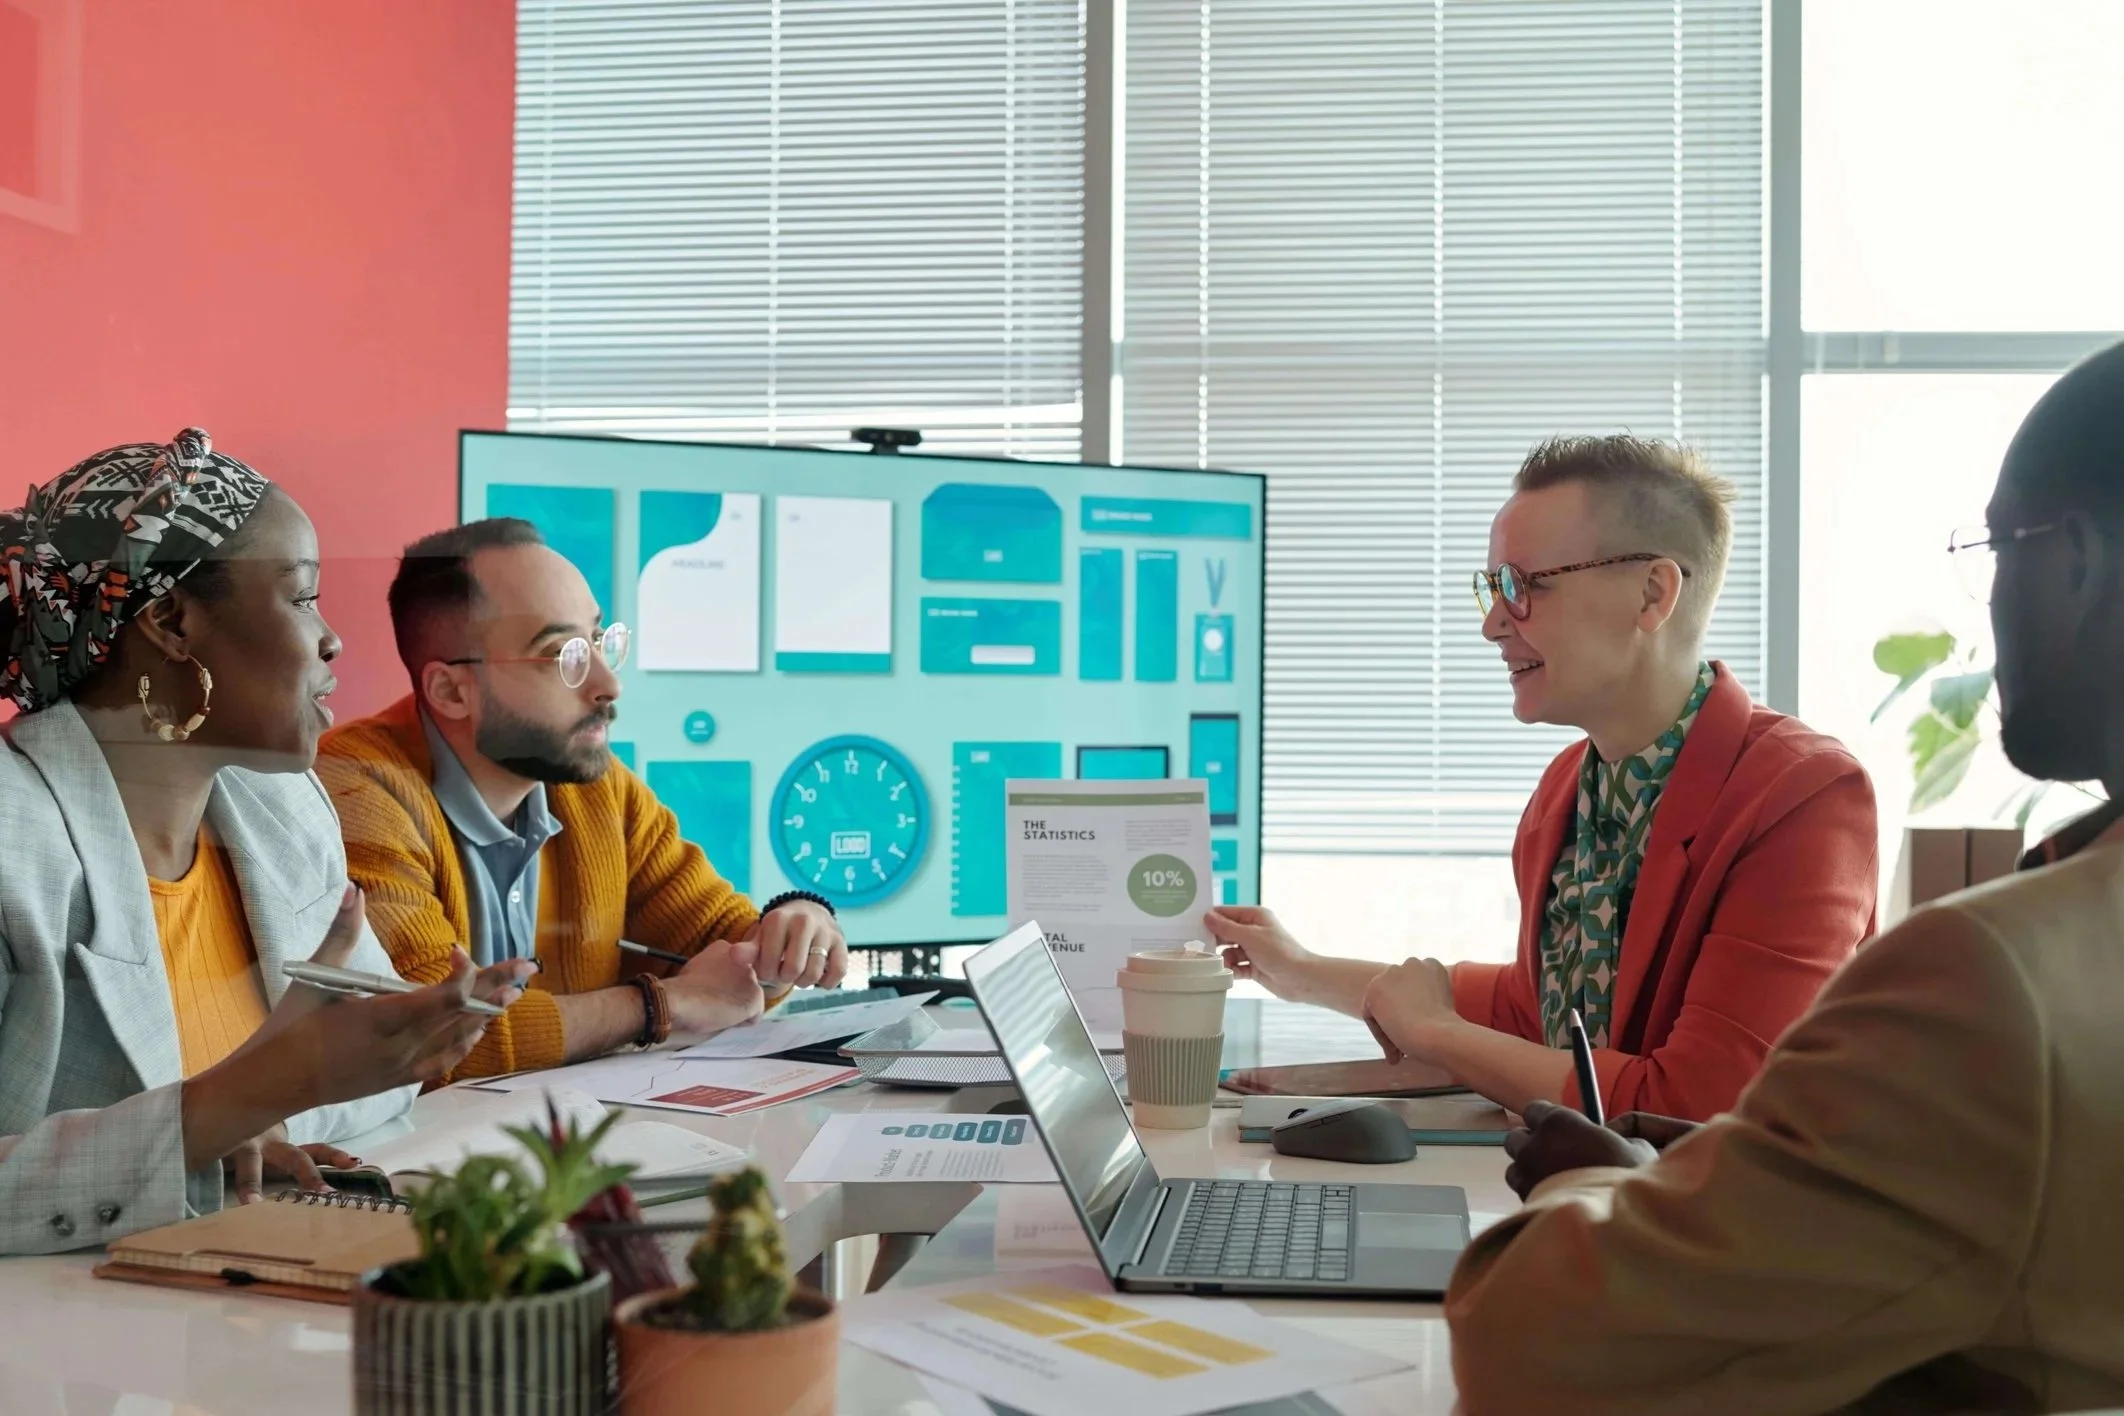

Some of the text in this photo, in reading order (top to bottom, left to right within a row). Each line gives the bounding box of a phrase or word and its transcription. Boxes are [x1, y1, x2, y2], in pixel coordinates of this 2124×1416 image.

[1023, 820, 1047, 830] THE
[1024, 830, 1096, 840] STATISTICS
[844, 866, 855, 881] 6
[1142, 870, 1185, 888] 10%
[1043, 932, 1068, 943] TAL
[1048, 943, 1086, 953] ENUE
